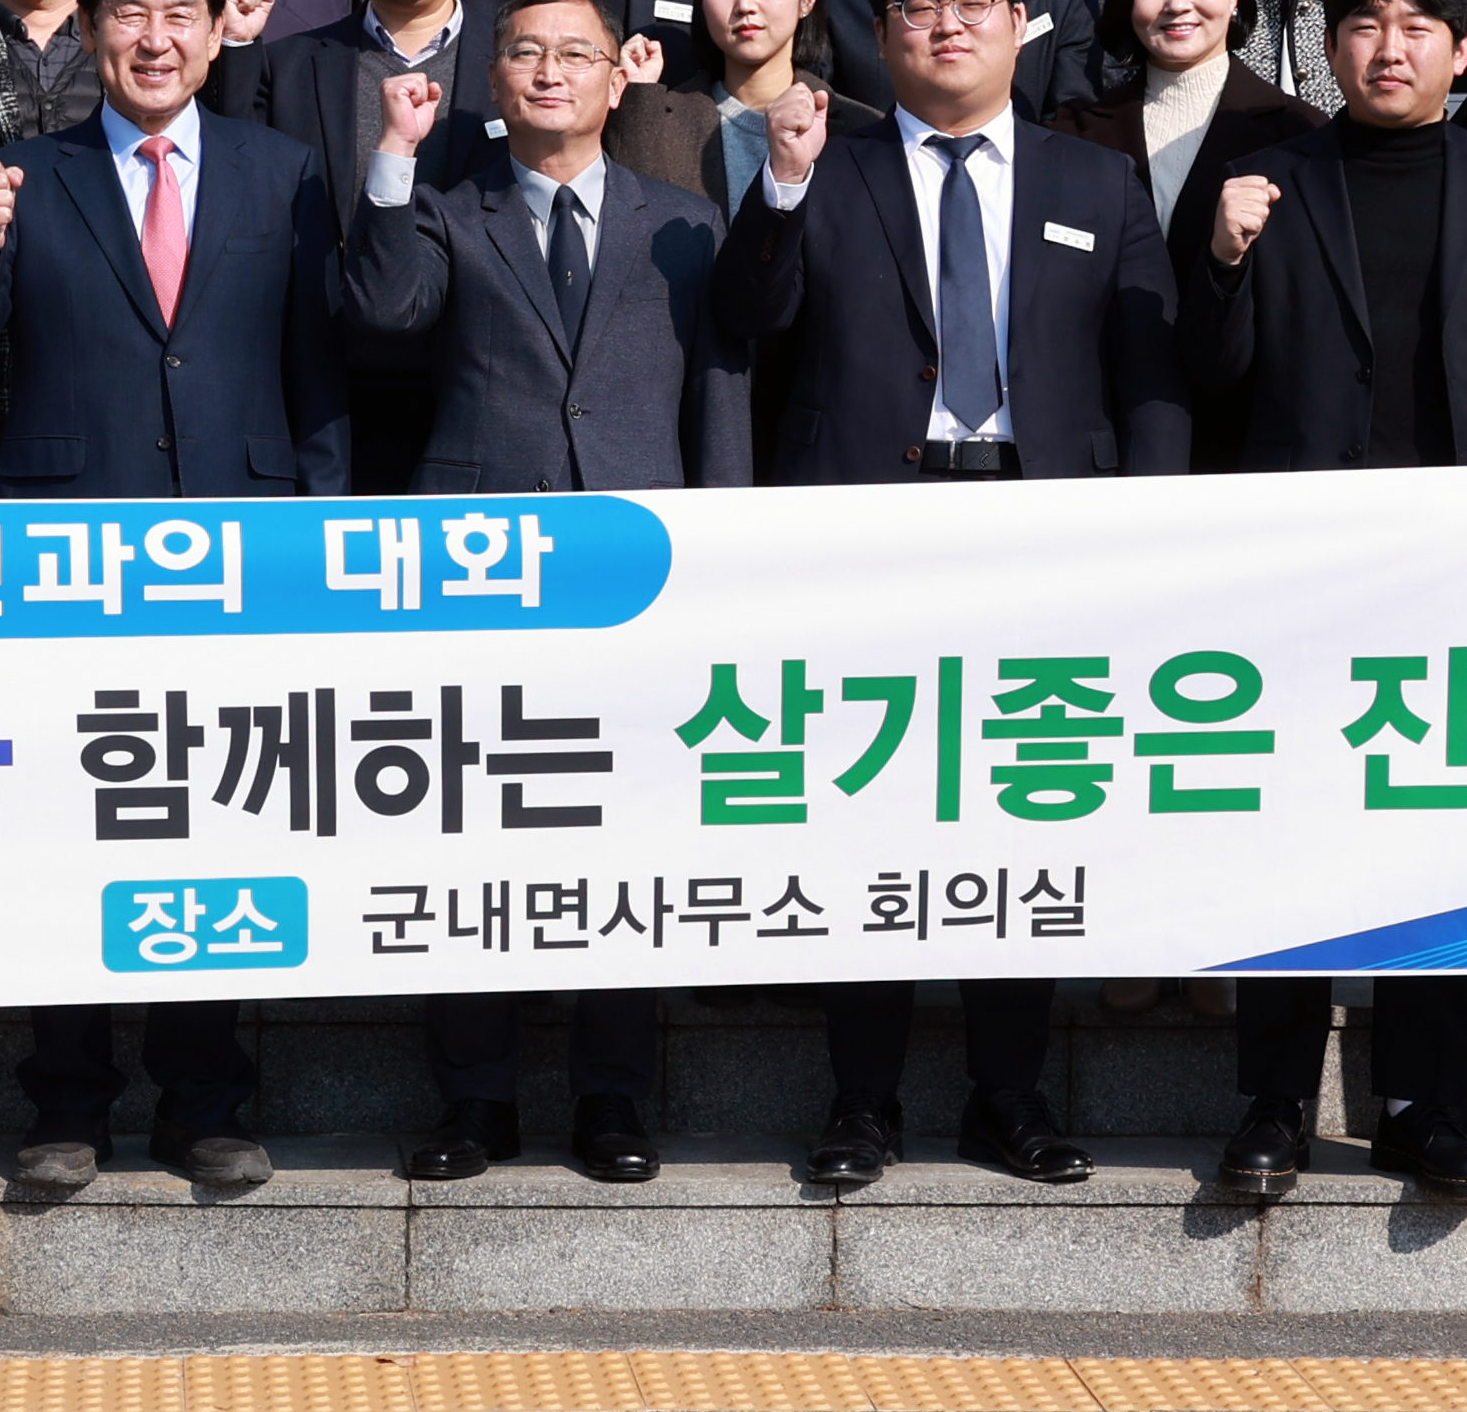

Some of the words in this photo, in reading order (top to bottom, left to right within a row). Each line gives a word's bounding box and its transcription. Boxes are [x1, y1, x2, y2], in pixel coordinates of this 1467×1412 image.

[323, 512, 554, 610] 대화
[75, 684, 614, 842] 함께하는
[675, 650, 1276, 826] 살기좋은
[128, 888, 283, 963] 장소
[361, 874, 830, 955] 군내면사무소
[862, 865, 1089, 942] 회의실
